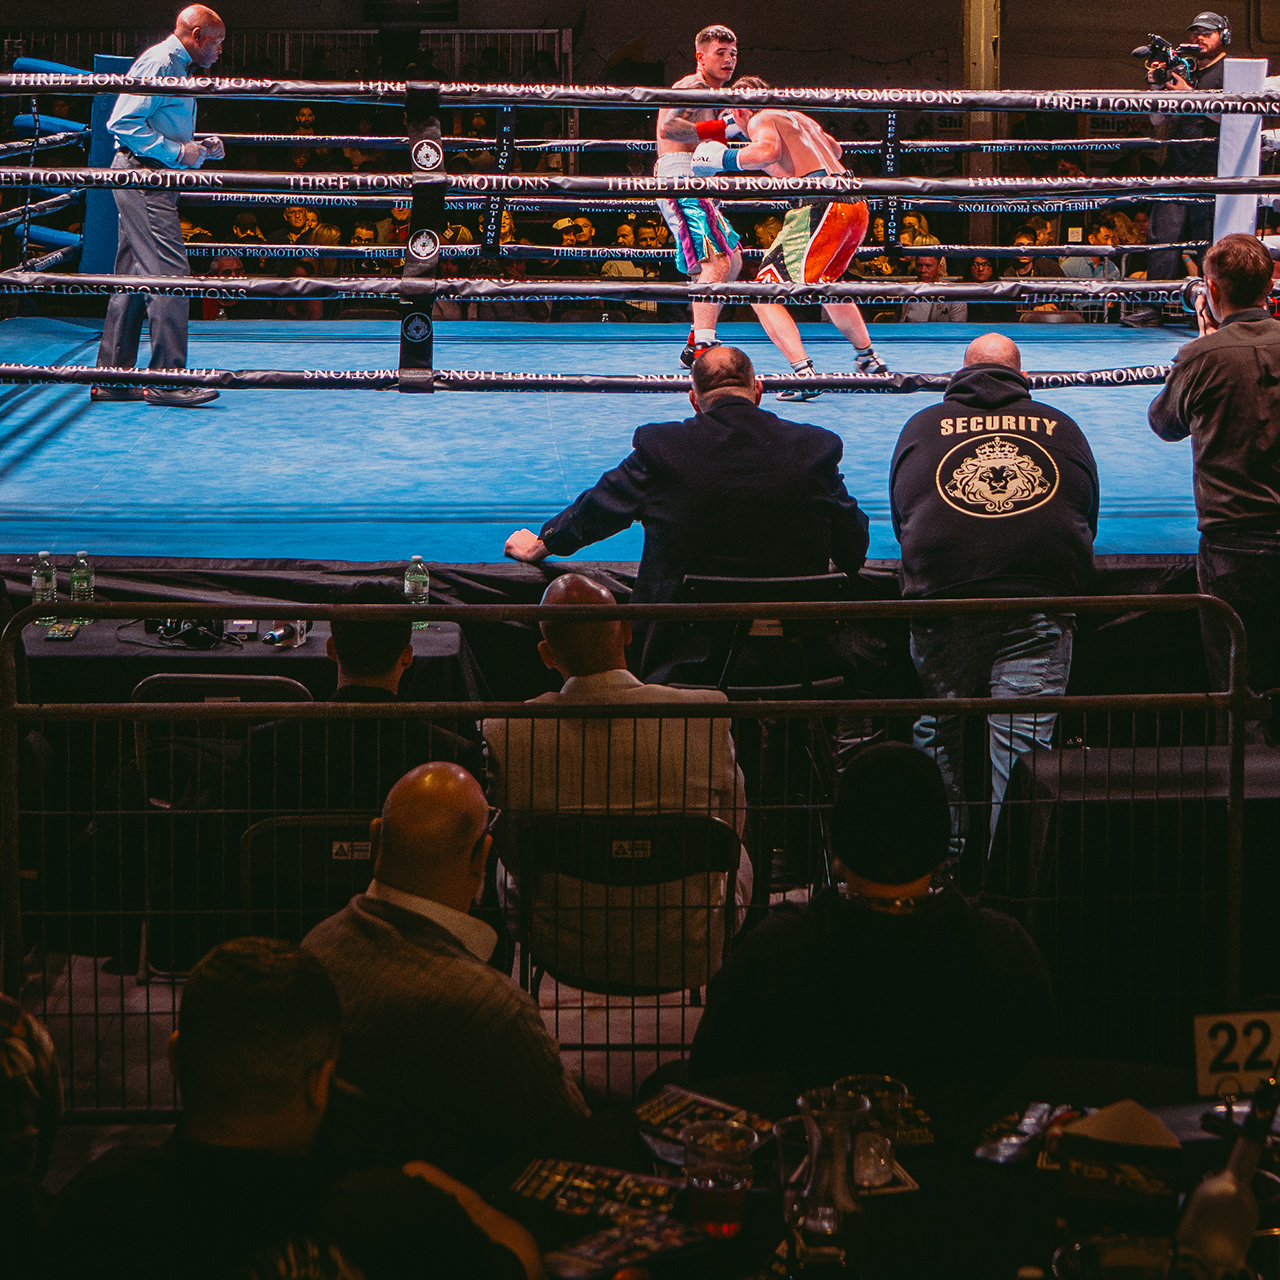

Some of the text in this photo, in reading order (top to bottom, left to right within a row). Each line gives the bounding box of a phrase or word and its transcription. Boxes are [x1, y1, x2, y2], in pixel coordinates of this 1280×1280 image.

[8, 73, 272, 89] THREE LIONS PROMOTIONS
[359, 81, 406, 93] THRE
[486, 83, 616, 95] PROMOTIONS
[773, 88, 831, 100] LIONS
[835, 88, 963, 105] PROMOTIONS
[1033, 96, 1280, 114] THREE LIONS PROMOTIONS
[980, 145, 1015, 153] THREE
[1051, 144, 1121, 152] PROMOTIONS
[29, 172, 90, 187] LIONS
[94, 173, 224, 189] PROMOTIONS
[285, 175, 350, 190] THREE
[355, 174, 413, 189] LIONS
[606, 176, 863, 191] THREE LIONS PROMOTIONS
[969, 177, 1027, 187] THREE
[211, 194, 358, 207] THREE LIONS PROMOTIONS
[959, 200, 1100, 214] THREE LIONS PROMOTIONS
[486, 196, 501, 245] MOTIONS
[886, 195, 897, 242] MOTIONS
[212, 248, 244, 258] LIONS
[246, 248, 320, 259] PROMOTIONS
[363, 249, 399, 259] THREE
[552, 248, 587, 258] THREE
[589, 248, 621, 258] LIONS
[49, 284, 108, 295] LIONS
[113, 285, 248, 299] PROMOTIONS
[688, 293, 946, 305] THREE LIONS PROMOTIONS
[1020, 293, 1083, 303] THREE
[1094, 292, 1143, 303] LIONS
[1029, 372, 1087, 389] LIONS
[940, 415, 1058, 436] SECURITY
[1208, 1019, 1274, 1073] 22
